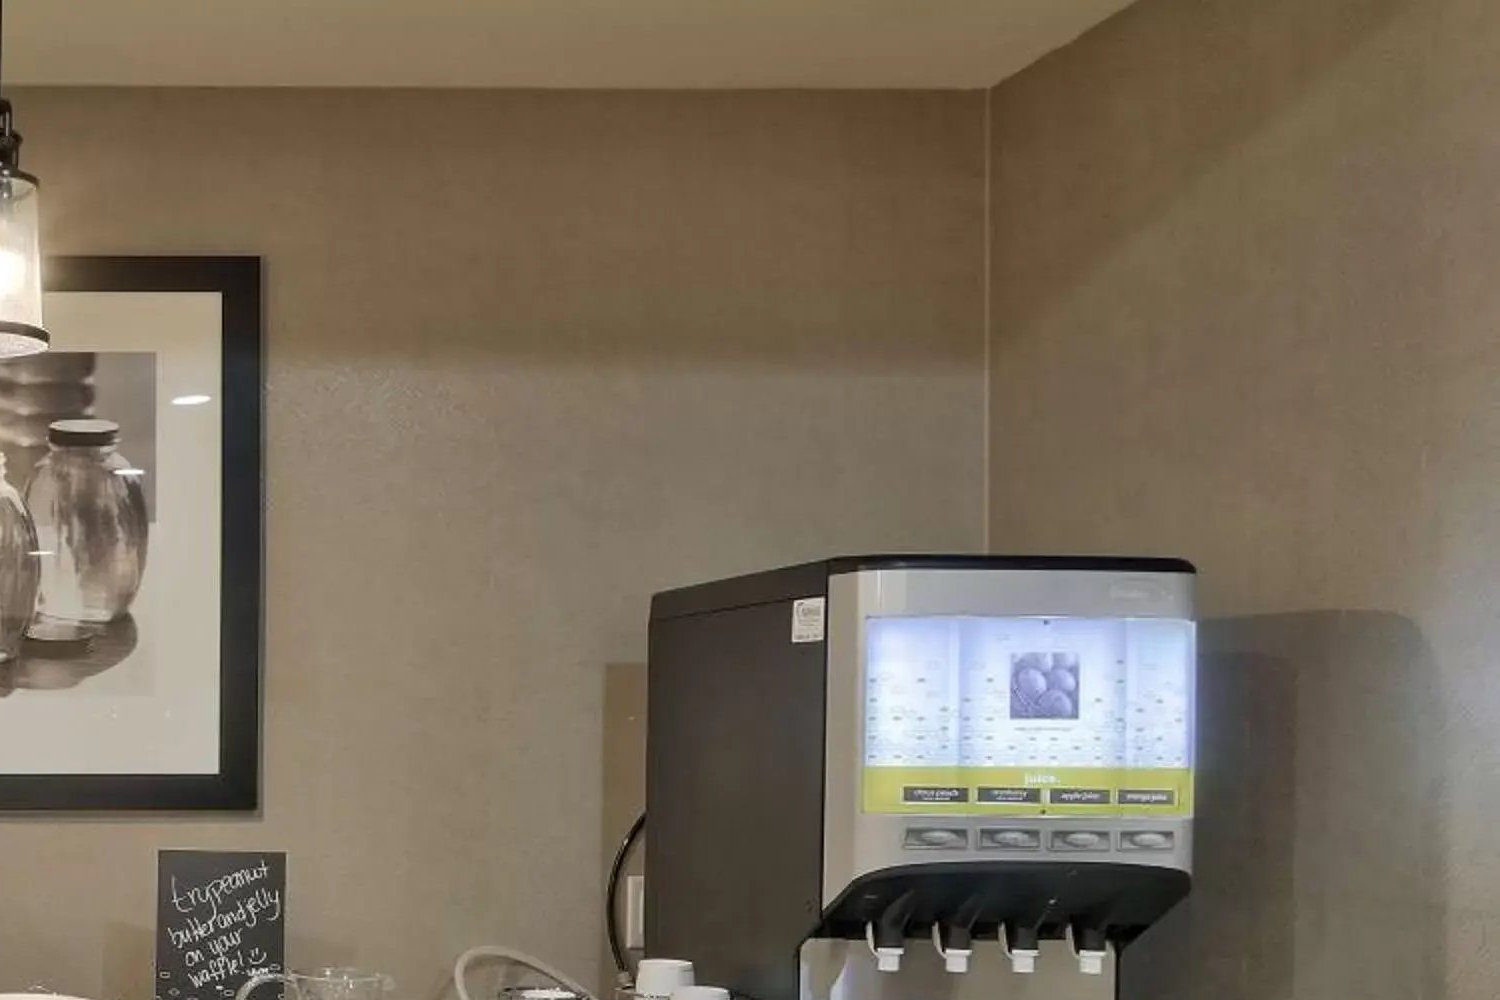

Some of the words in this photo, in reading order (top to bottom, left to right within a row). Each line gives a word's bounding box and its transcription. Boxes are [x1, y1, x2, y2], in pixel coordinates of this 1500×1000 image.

[211, 859, 268, 904] peanut
[167, 917, 215, 948] butter
[216, 900, 247, 929] and
[245, 887, 280, 927] jelly
[185, 949, 205, 967] on
[207, 927, 242, 957] your
